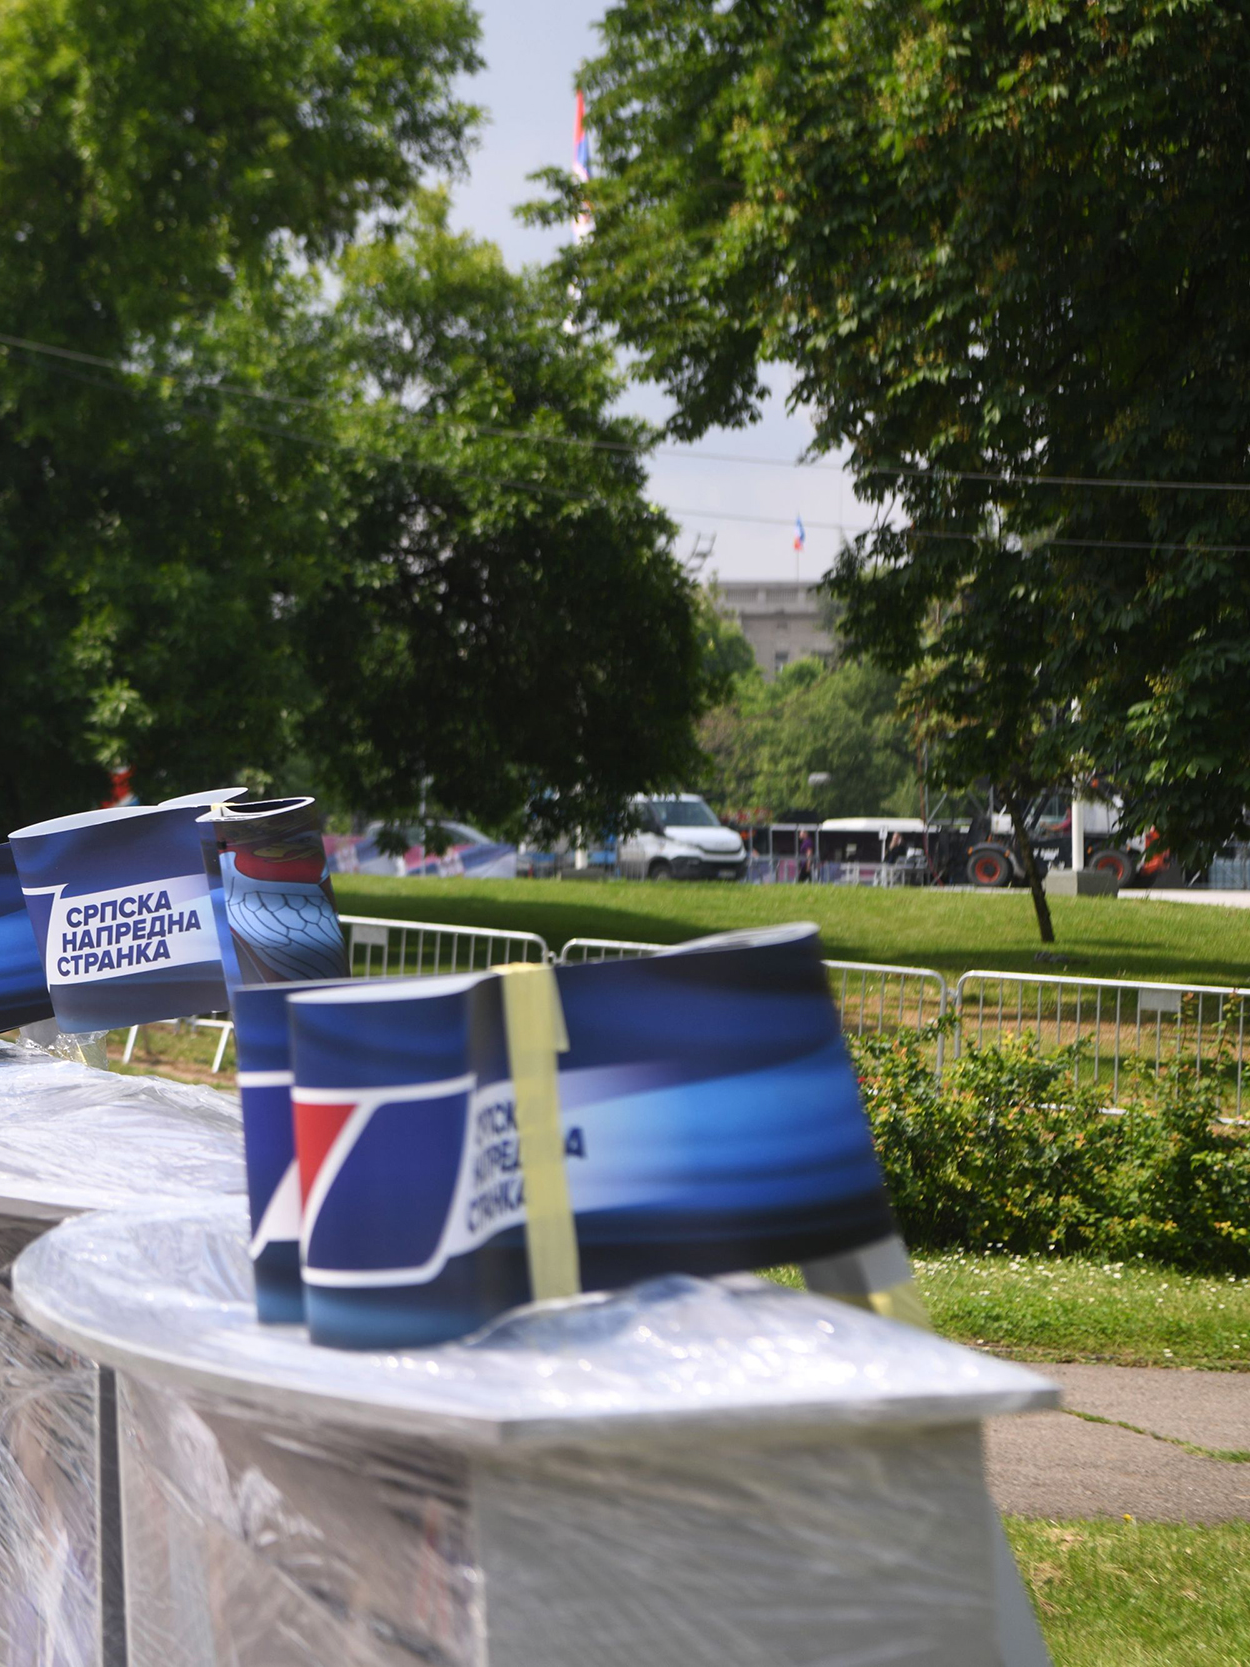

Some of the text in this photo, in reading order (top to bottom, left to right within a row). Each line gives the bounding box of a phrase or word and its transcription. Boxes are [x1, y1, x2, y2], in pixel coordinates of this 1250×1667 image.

[66, 890, 172, 928] СРПСКА
[62, 910, 202, 953] НАПРЕДНА
[57, 939, 171, 977] СТРАНКА
